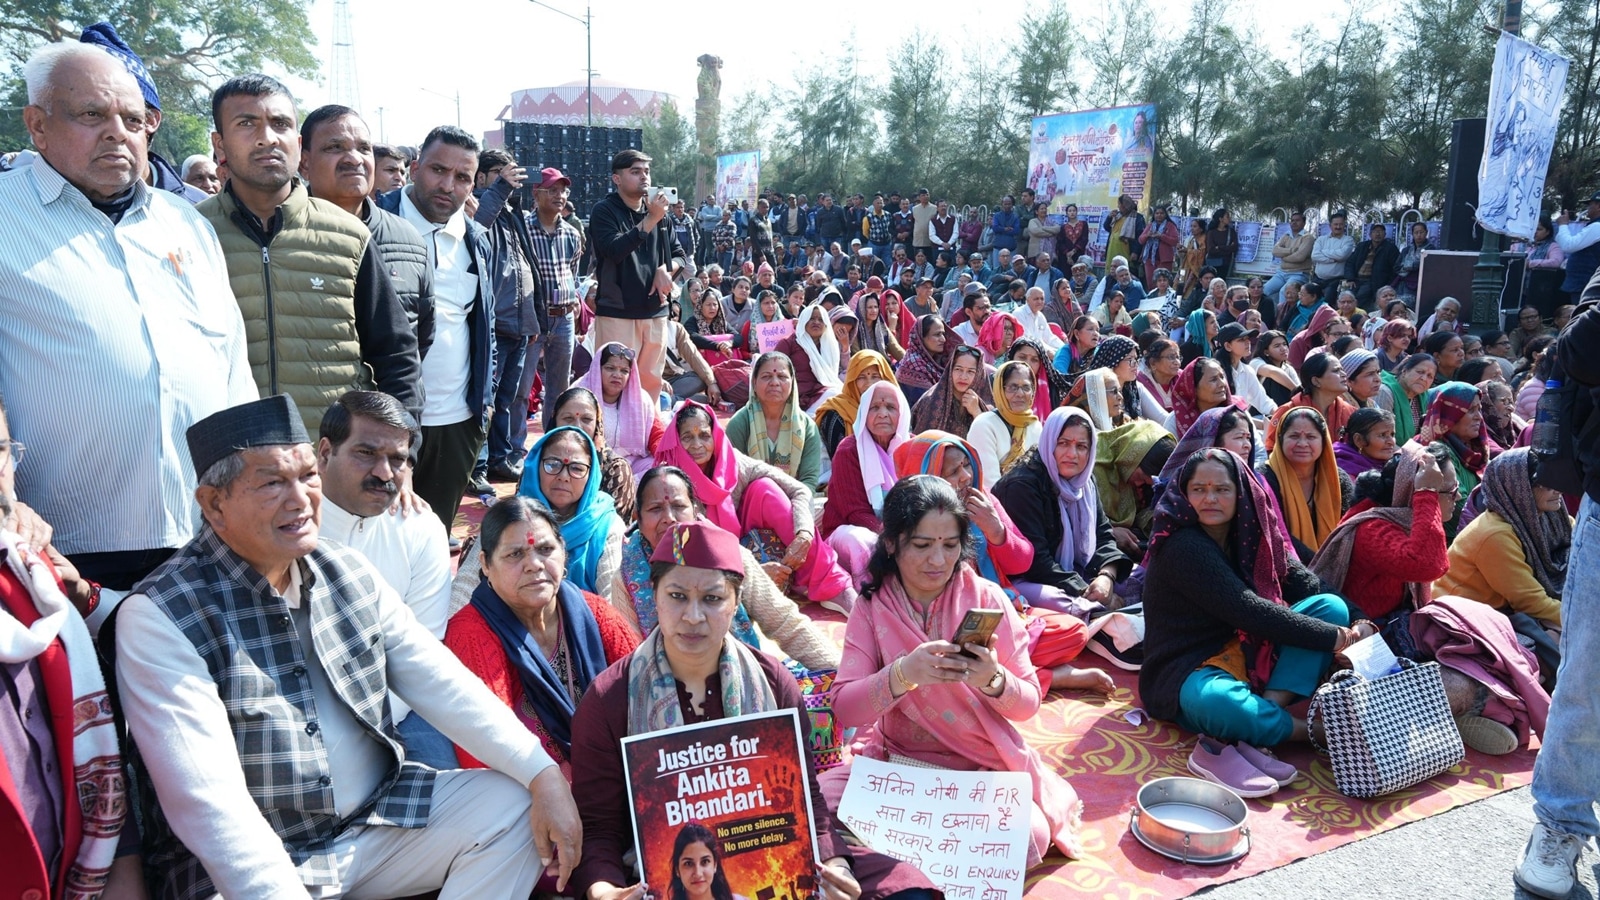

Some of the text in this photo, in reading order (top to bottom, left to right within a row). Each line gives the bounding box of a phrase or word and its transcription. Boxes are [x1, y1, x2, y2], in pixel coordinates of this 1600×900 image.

[1093, 157, 1111, 166] 2026
[656, 735, 760, 773] Justice for
[677, 764, 751, 799] Ankita
[861, 772, 1021, 807] अनिल जोशी की FIR
[665, 783, 772, 827] Bhandari.
[876, 805, 906, 824] सत्ता
[911, 811, 933, 830] का
[941, 813, 990, 834] छलावा
[717, 817, 789, 838] No more silence.
[724, 833, 787, 853] No more delay.
[884, 828, 934, 853] सरकार
[937, 831, 962, 856] को
[968, 842, 1011, 860] जनता
[928, 862, 959, 879] CBI
[967, 866, 1020, 881] ENQUIRY
